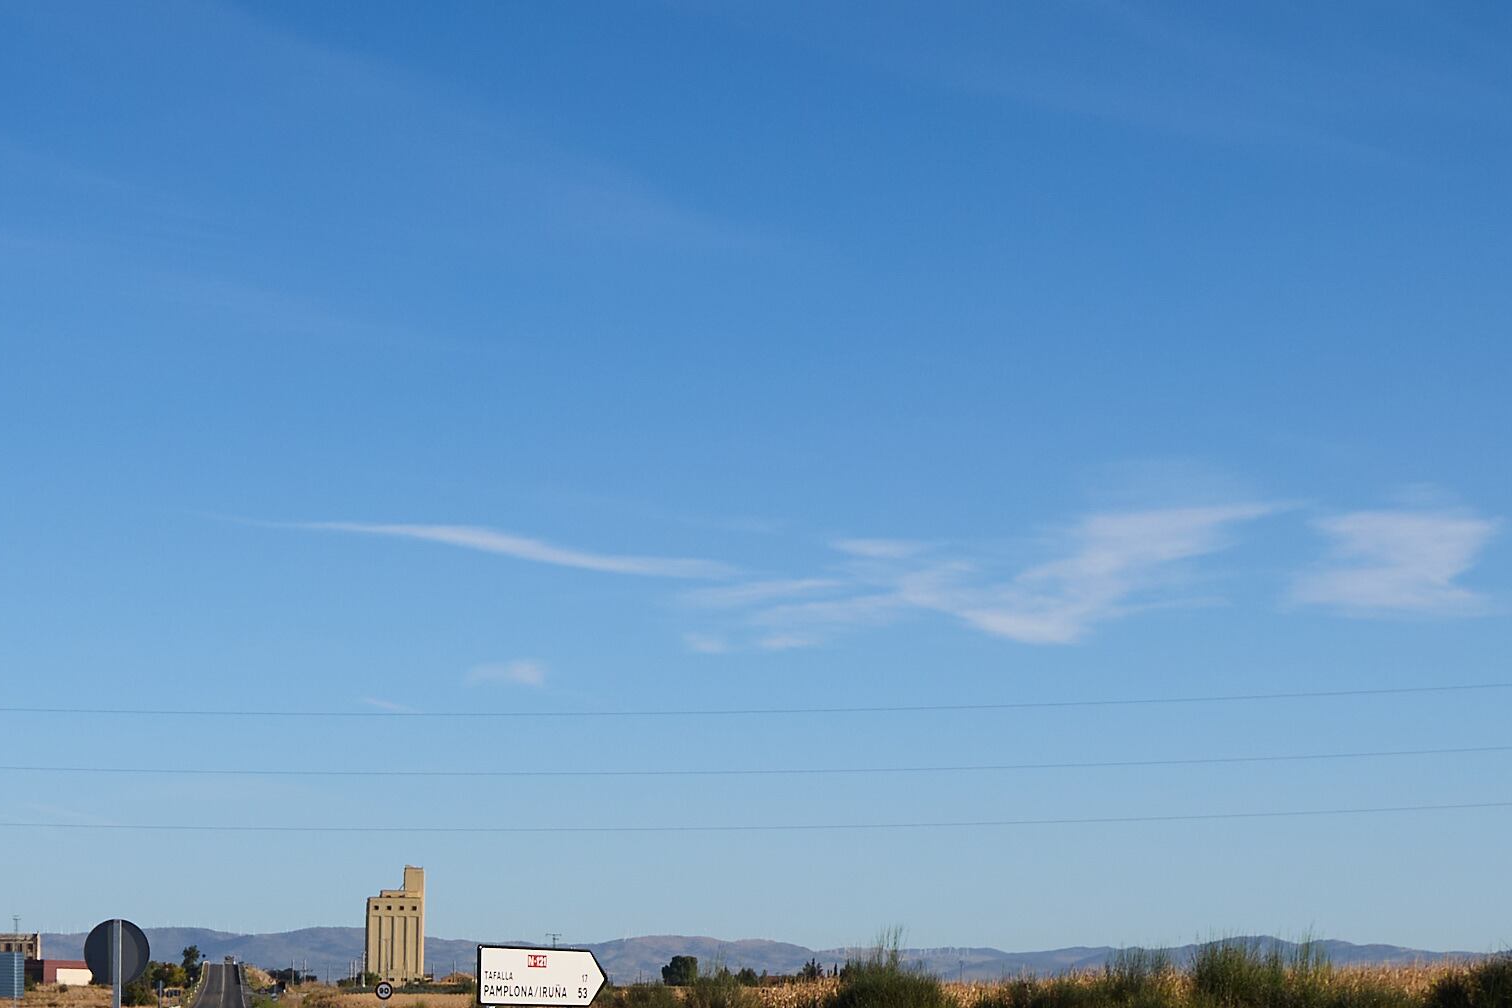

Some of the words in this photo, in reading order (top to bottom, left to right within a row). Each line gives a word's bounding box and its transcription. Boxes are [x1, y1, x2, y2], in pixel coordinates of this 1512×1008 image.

[528, 955, 547, 967] N-121
[484, 970, 513, 981] TAFALLA
[581, 974, 588, 983] 17
[378, 987, 389, 995] 90
[483, 983, 567, 998] PAMPLONA/IRUÑA
[577, 987, 588, 999] 53
